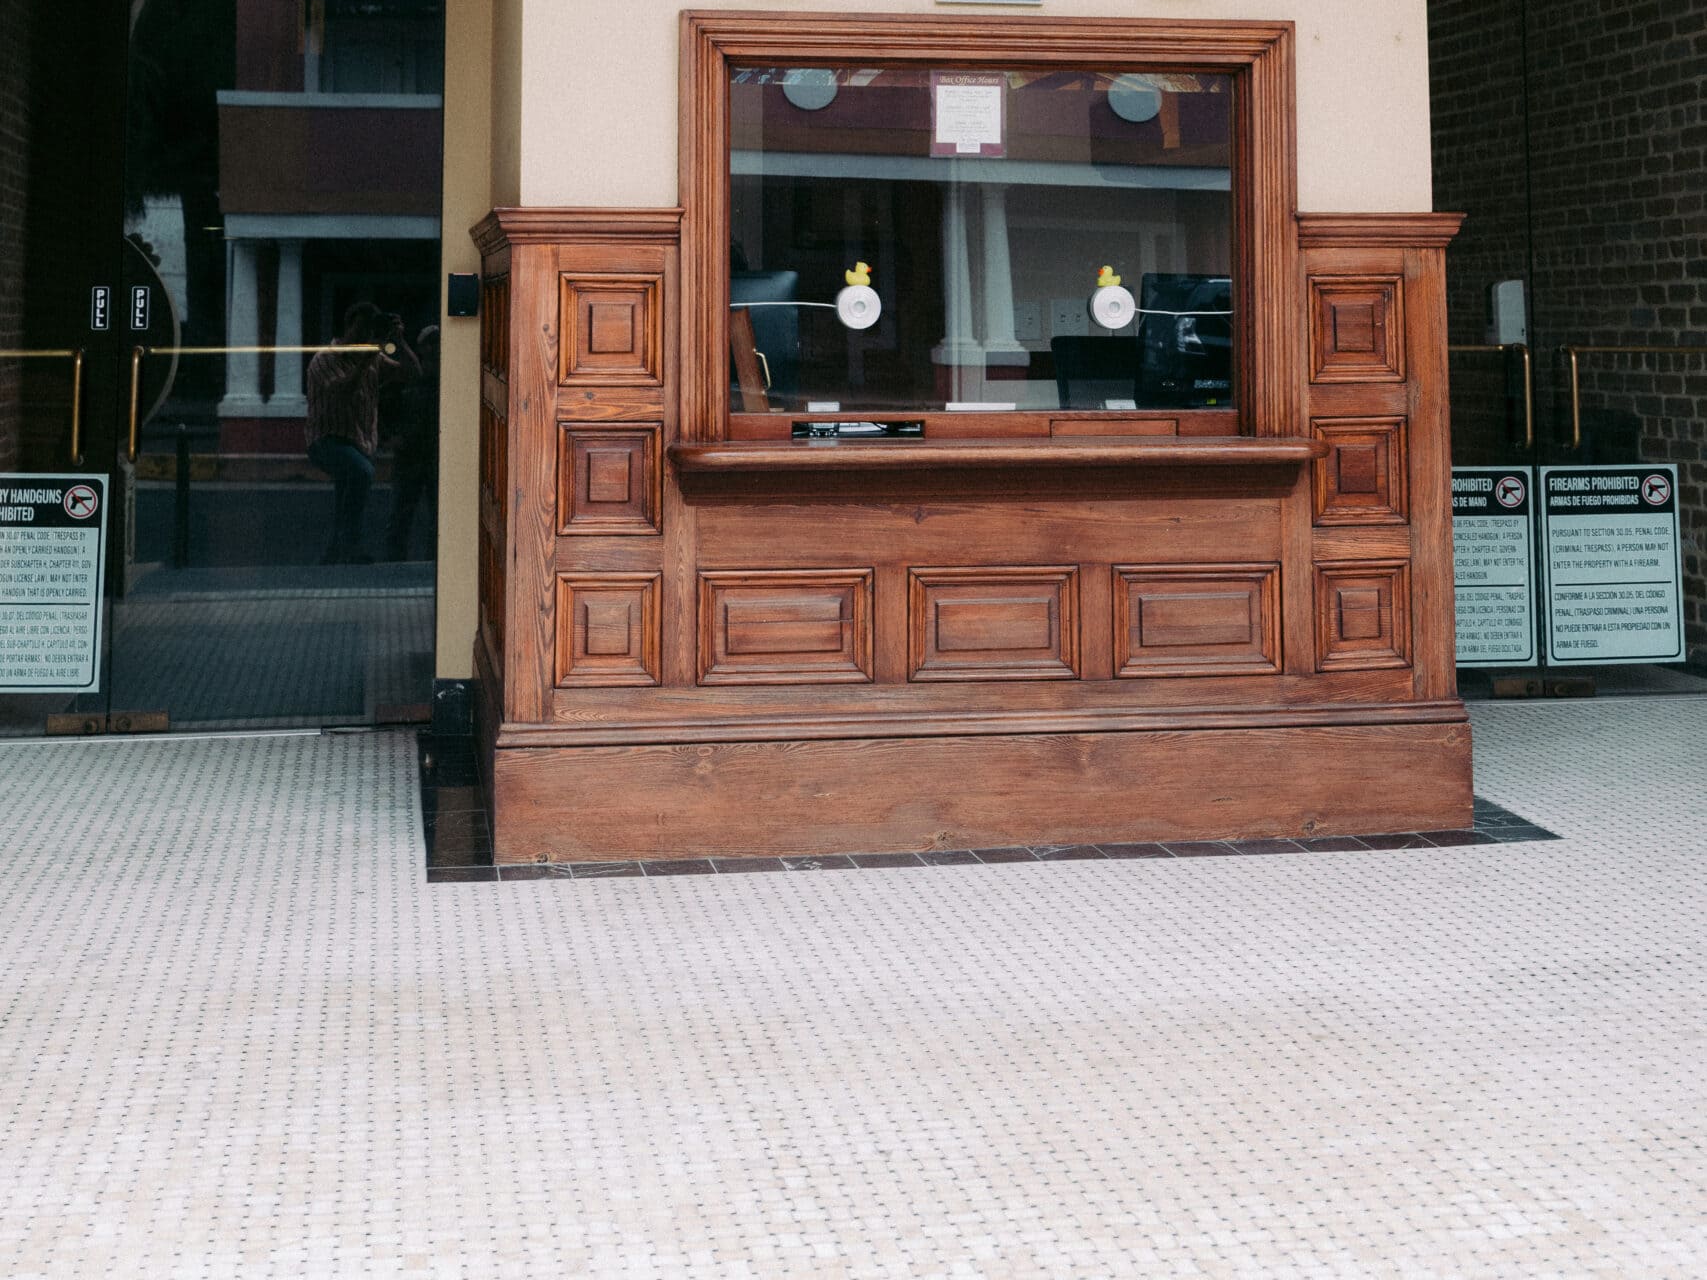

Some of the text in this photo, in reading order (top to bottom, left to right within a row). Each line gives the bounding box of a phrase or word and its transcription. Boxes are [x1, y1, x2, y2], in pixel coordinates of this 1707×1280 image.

[955, 75, 977, 86] Office
[95, 289, 105, 327] PULL
[135, 289, 145, 327] PULL
[1549, 476, 1640, 491] FIREARMS PROHIBITED
[10, 488, 62, 504] HANDGUNS
[1459, 496, 1468, 507] DE
[1468, 496, 1488, 507] MANO
[1550, 494, 1639, 507] ARMAS DE FUEGO PROHIBIDAS
[1552, 528, 1582, 538] PURSUANT
[1583, 528, 1591, 537] TO
[1591, 527, 1615, 537] SECTION
[1635, 527, 1653, 536] PENAL
[1616, 543, 1621, 551] A
[1621, 542, 1644, 552] PERSON
[1645, 542, 1657, 551] MAY
[1657, 542, 1669, 551] NOT
[1553, 560, 1571, 570] ENTER
[1583, 559, 1613, 569] PROPERTY
[1554, 591, 1584, 601] CONFORME
[1589, 591, 1596, 600] LA
[1644, 605, 1669, 615] PERSONA
[1555, 624, 1564, 633] NO
[1564, 624, 1582, 633] PUEDE
[1582, 623, 1603, 632] ENTRAR
[1607, 623, 1620, 632] ESTA
[1621, 622, 1650, 631] PROPIEDAD
[1651, 622, 1662, 631] CON
[1556, 640, 1573, 649] ARMA
